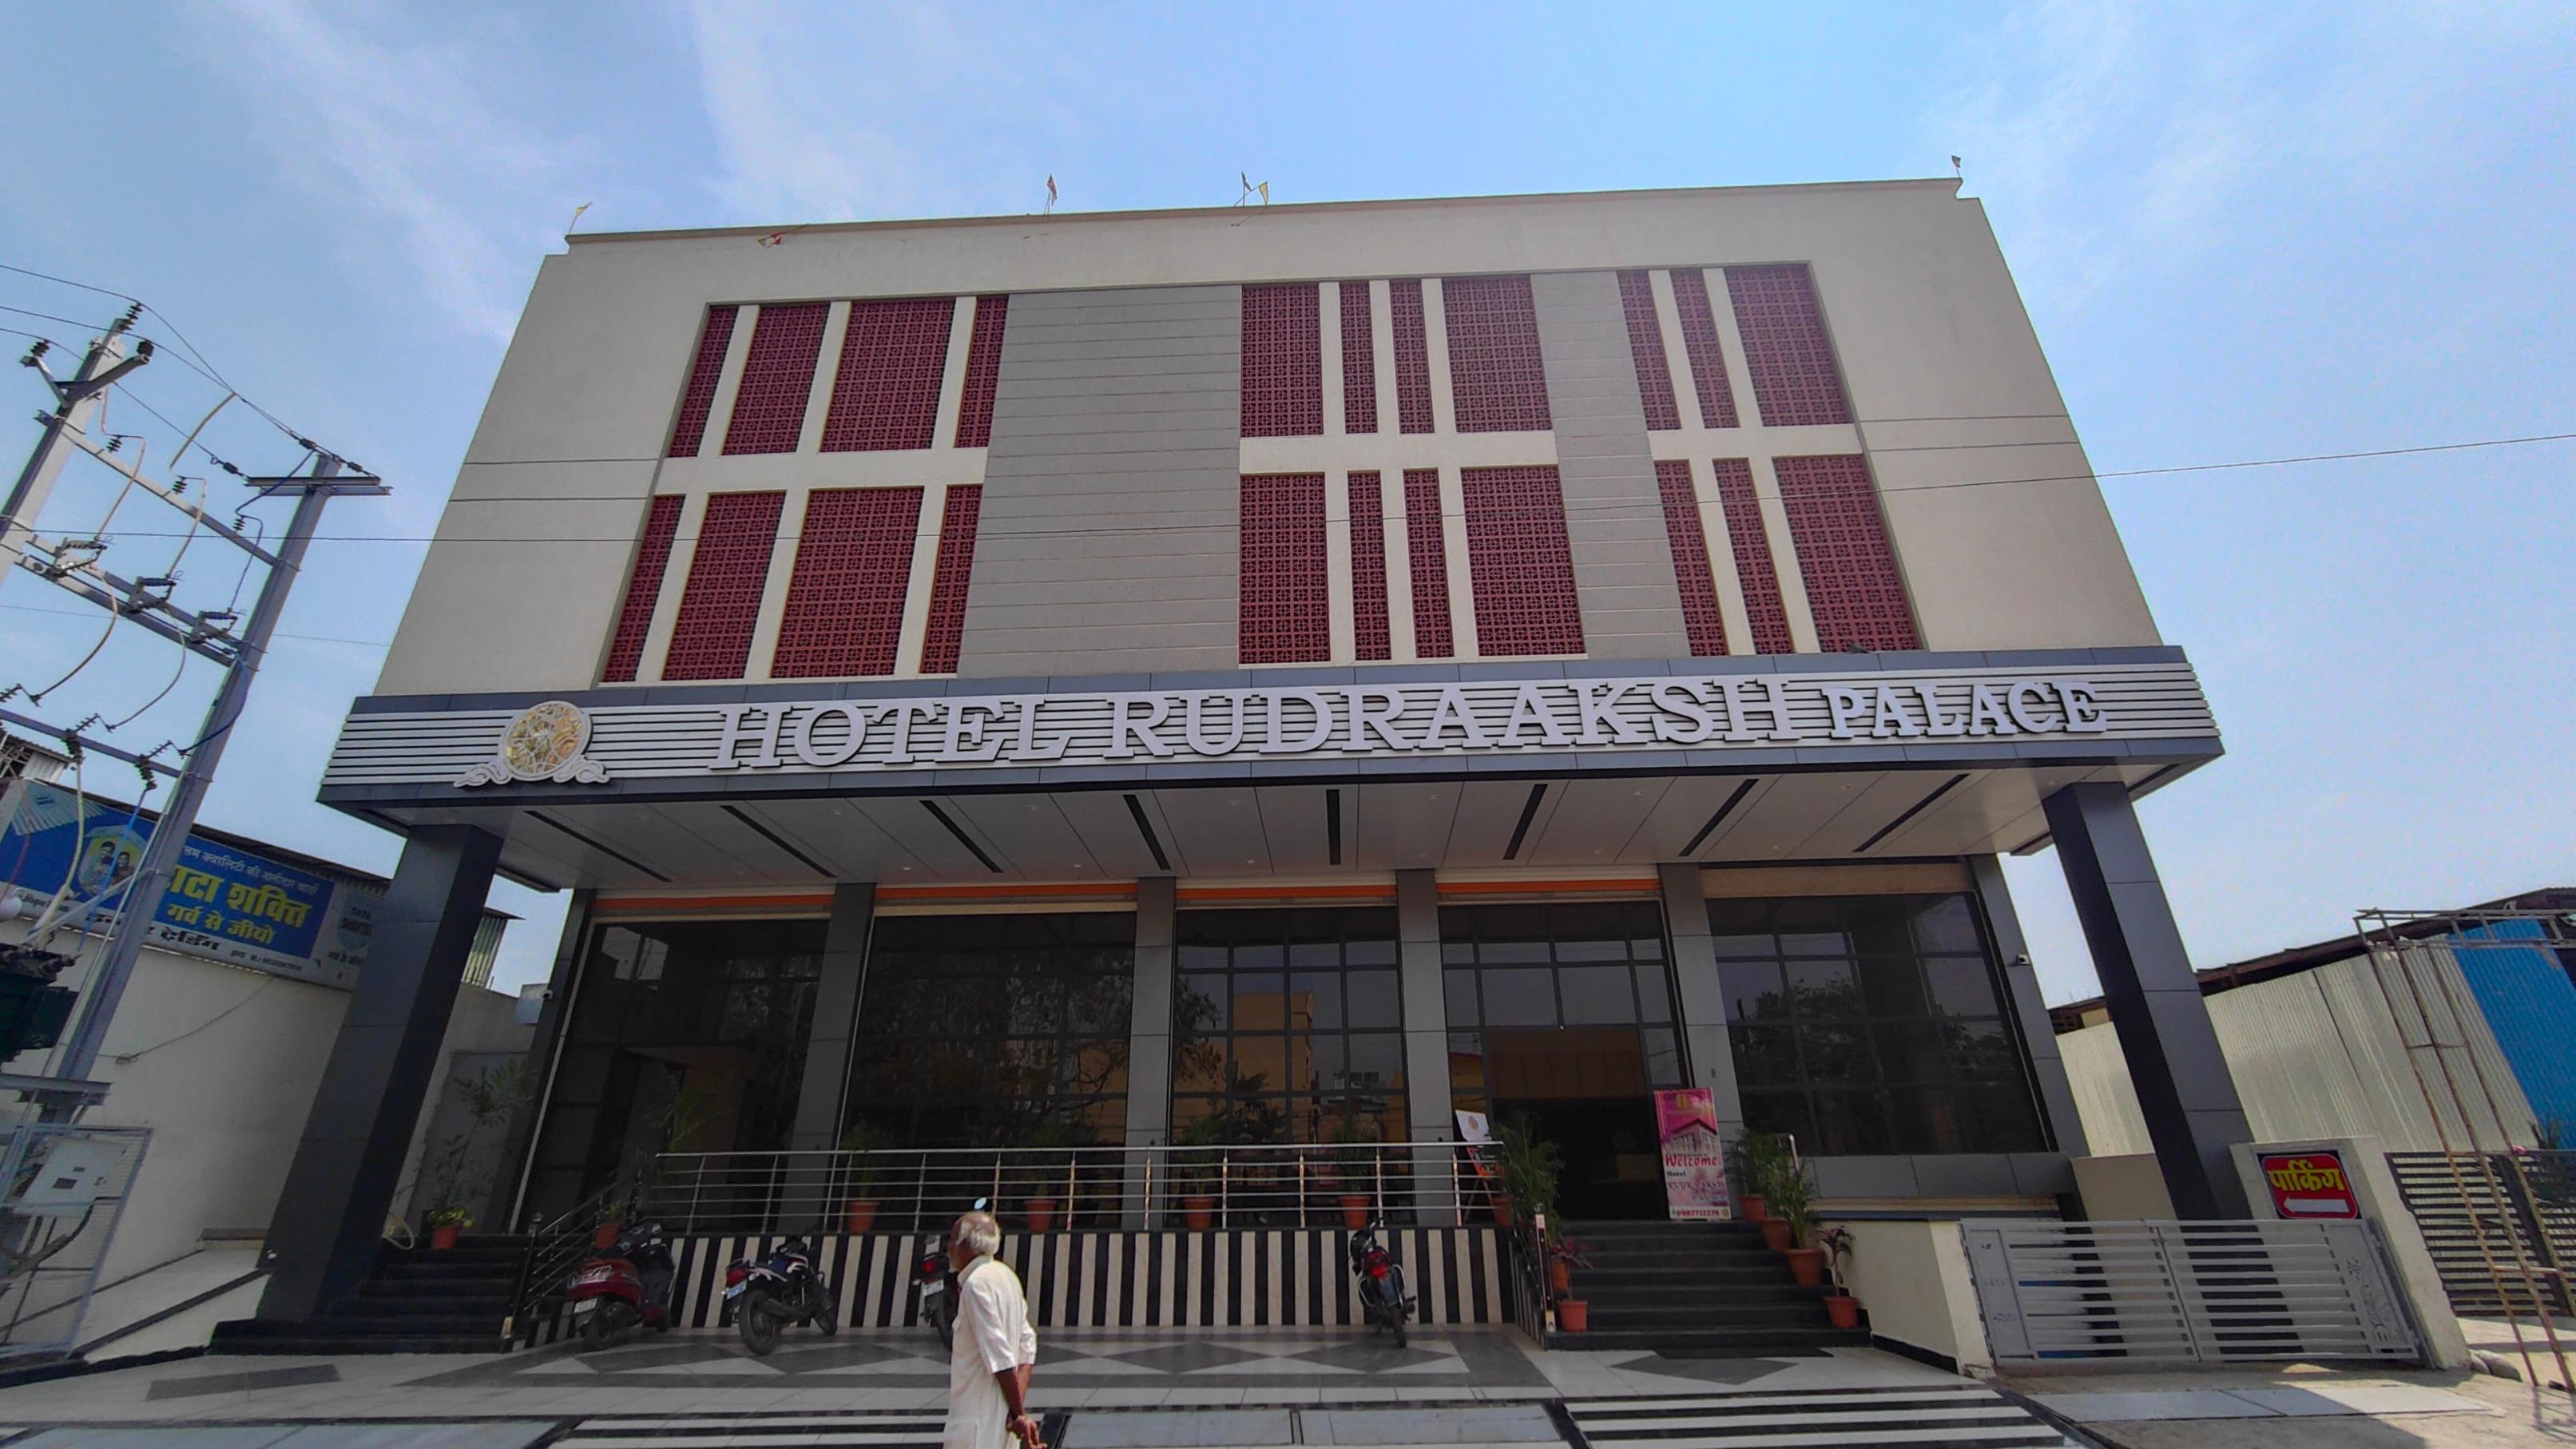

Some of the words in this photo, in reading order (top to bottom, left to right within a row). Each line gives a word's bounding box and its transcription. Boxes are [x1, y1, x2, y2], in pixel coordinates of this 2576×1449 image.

[708, 697, 1071, 769] HOTEL
[1102, 677, 1802, 759] RUDRAAKSH
[1821, 679, 2107, 739] PALACE
[166, 903, 204, 927] गर्व
[204, 910, 226, 931] से
[1665, 1153, 1718, 1167] Welcome
[2267, 1159, 2346, 1191] पार्किंग
